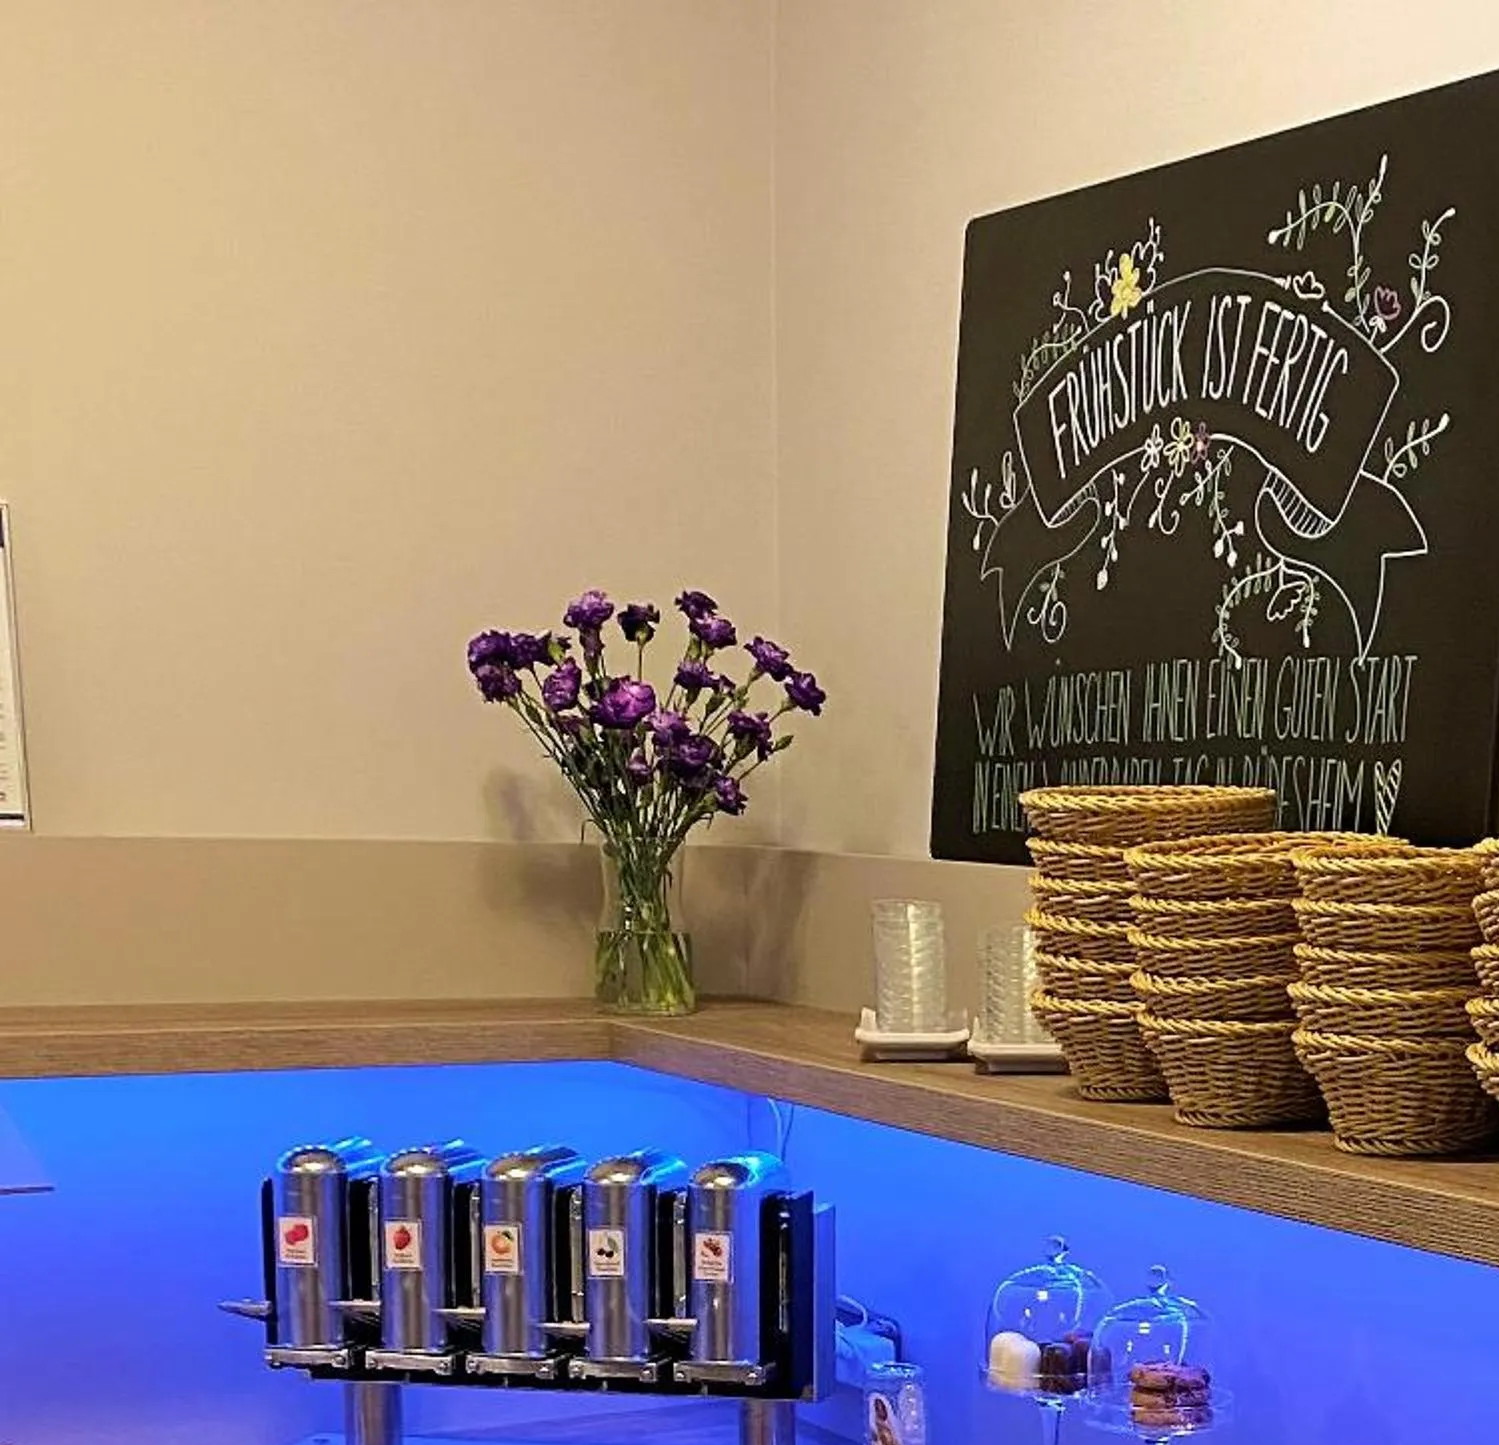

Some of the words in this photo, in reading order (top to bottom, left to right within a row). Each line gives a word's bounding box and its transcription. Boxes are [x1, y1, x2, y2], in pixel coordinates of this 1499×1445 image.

[1048, 299, 1192, 479] FRÜHSTÜCK
[1202, 294, 1252, 400] IST
[1242, 300, 1349, 454] FERTIG
[972, 684, 1016, 757] WIR
[1025, 657, 1132, 750] WÜNSCHEN
[1142, 658, 1201, 743] IHNEN
[1206, 658, 1269, 740] EINEN
[1274, 655, 1341, 743] GUTEN
[1346, 654, 1419, 745] START
